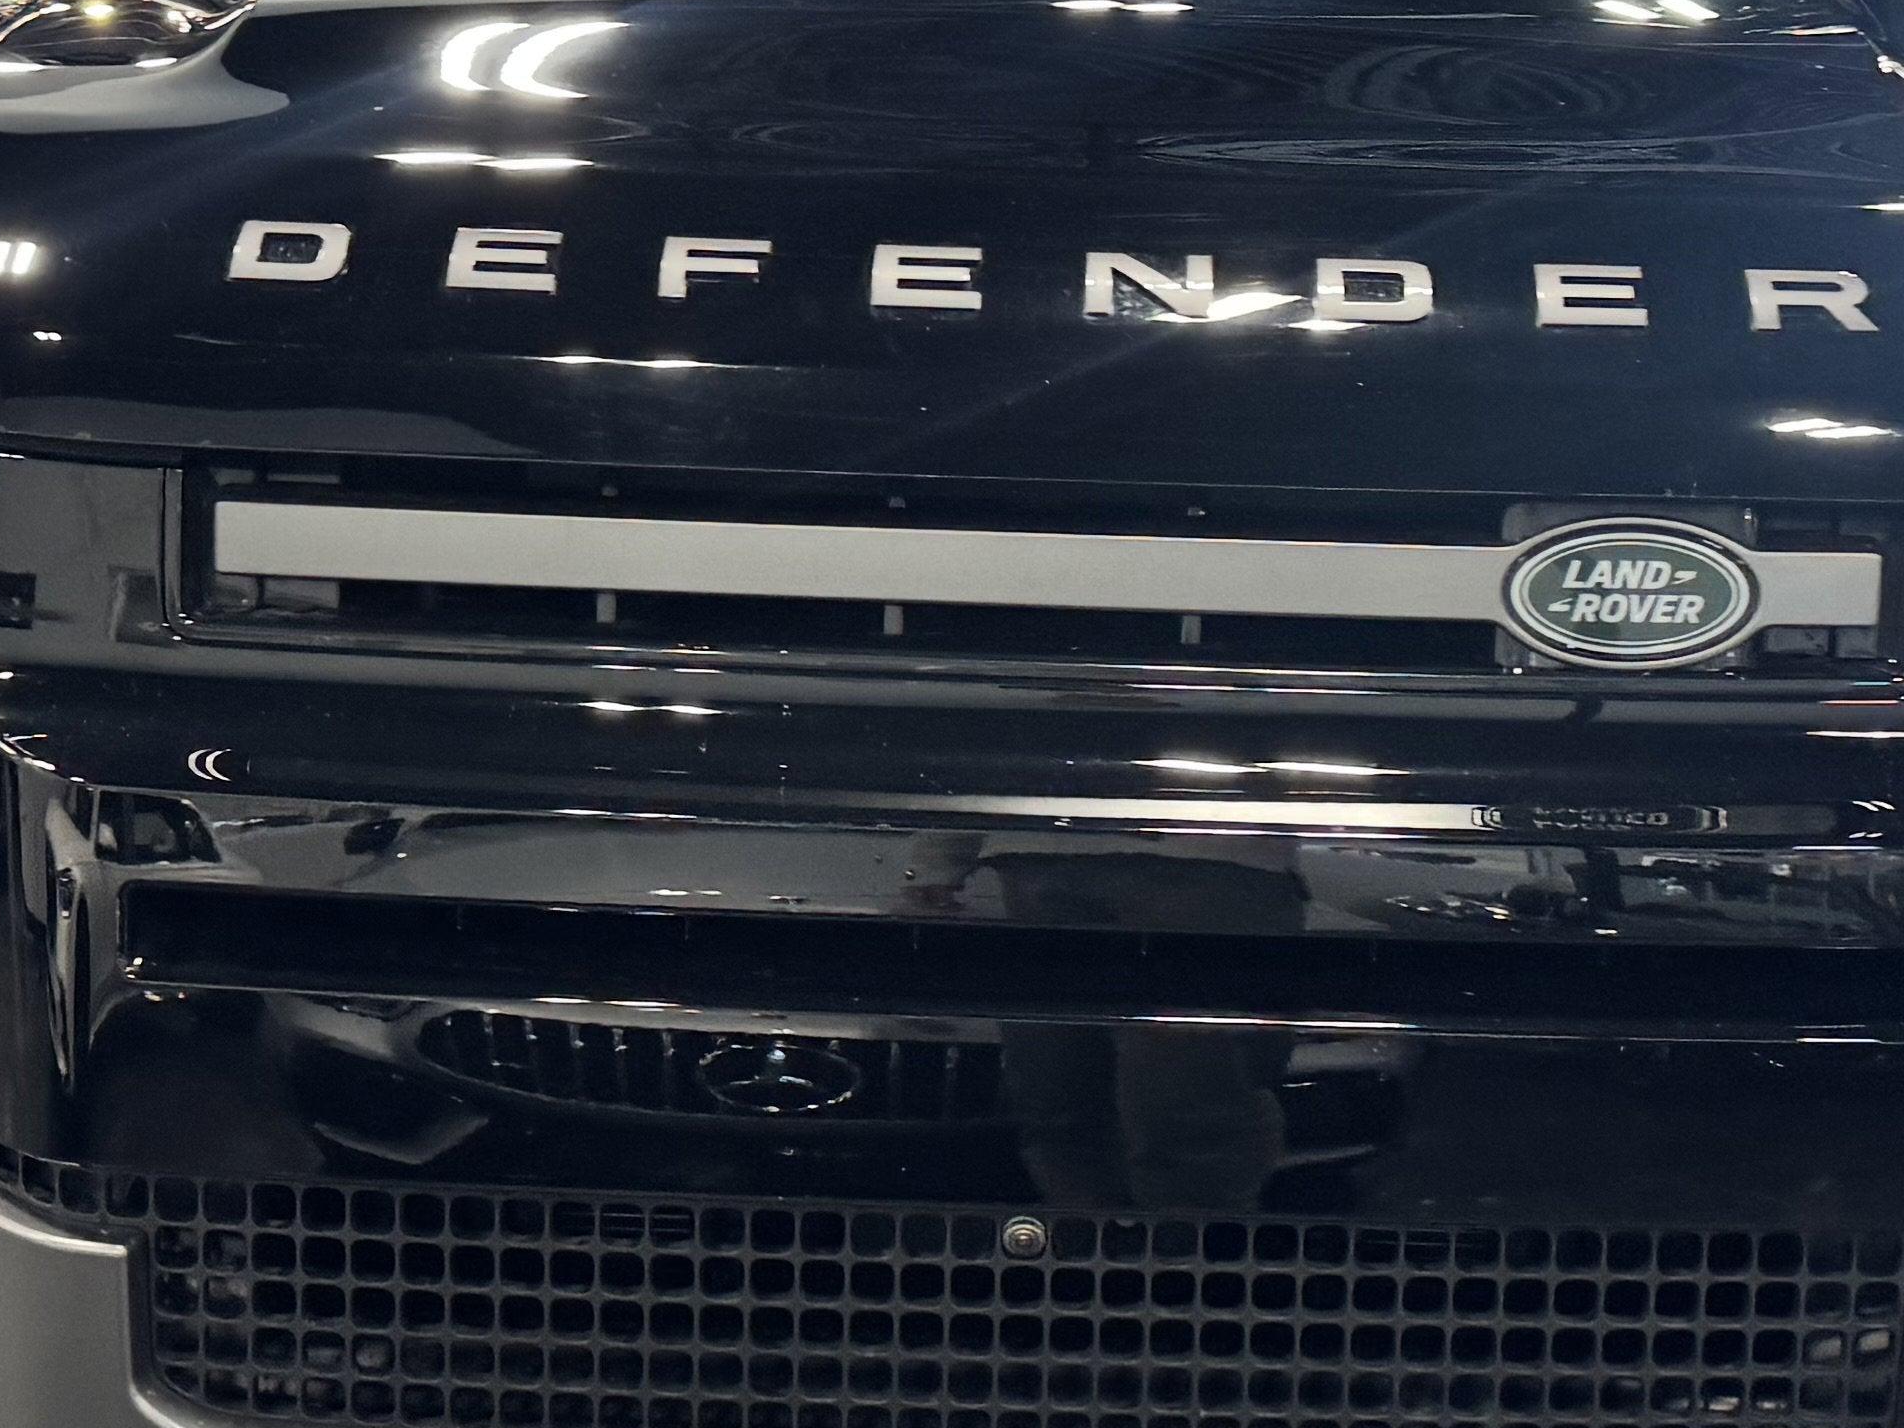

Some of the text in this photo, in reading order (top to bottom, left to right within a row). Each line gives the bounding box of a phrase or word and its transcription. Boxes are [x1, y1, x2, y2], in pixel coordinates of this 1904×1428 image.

[226, 219, 1880, 333] DEFENDER
[1562, 559, 1672, 590] LAND
[1570, 593, 1705, 624] ROVER
